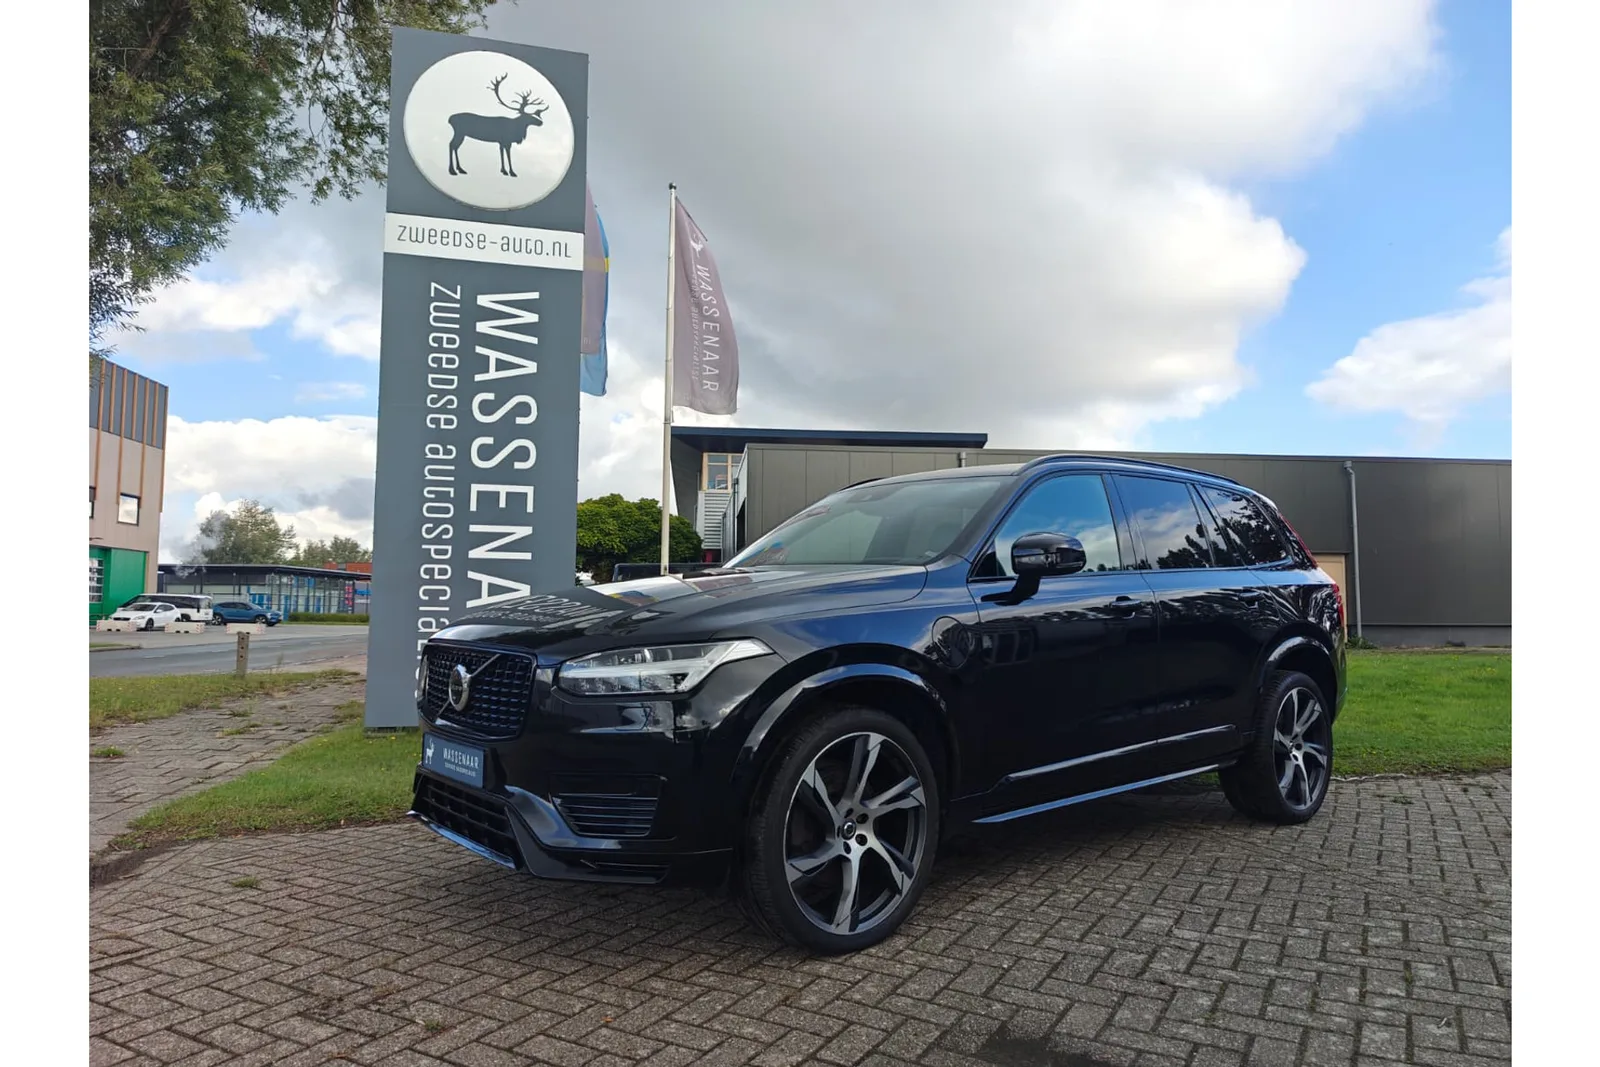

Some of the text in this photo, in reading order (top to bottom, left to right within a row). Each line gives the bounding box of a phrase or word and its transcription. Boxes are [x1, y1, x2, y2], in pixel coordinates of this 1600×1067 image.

[696, 264, 720, 391] WASSENAAR
[415, 281, 461, 698] zweedse autospecial
[465, 291, 540, 609] WASSENA
[443, 747, 479, 769] WASSENAAR
